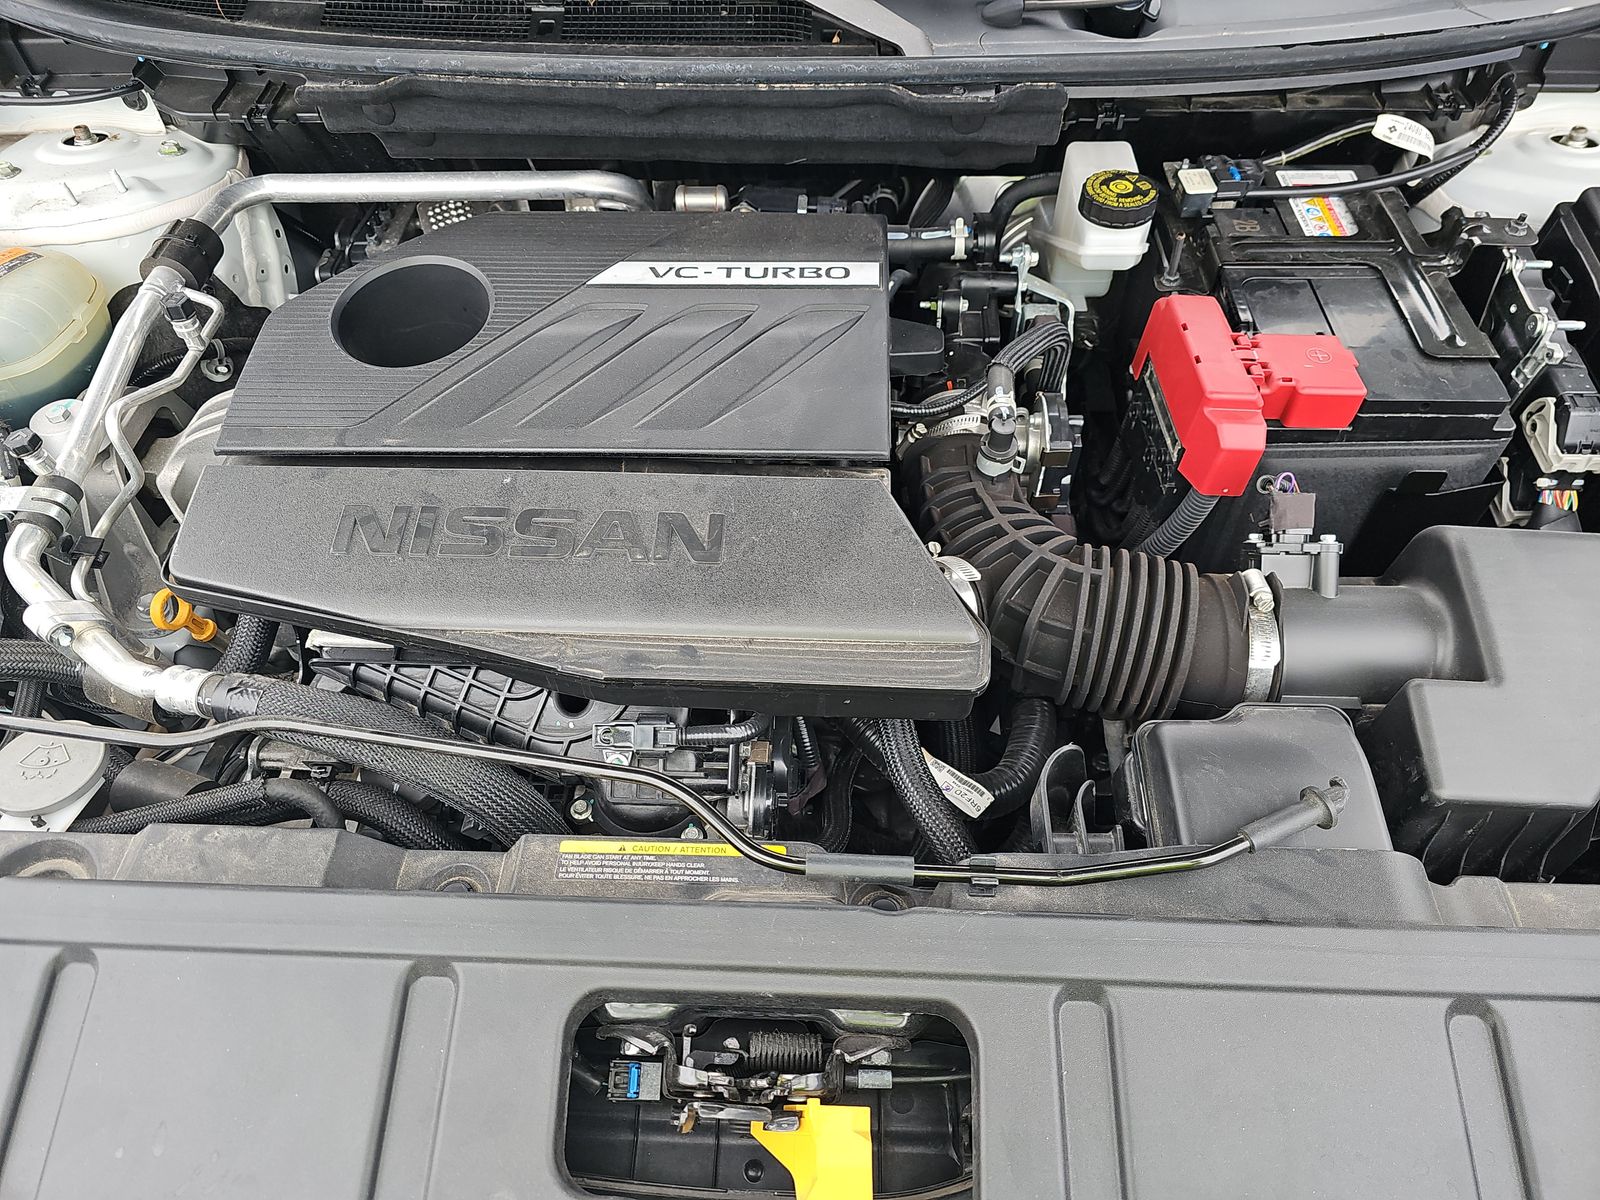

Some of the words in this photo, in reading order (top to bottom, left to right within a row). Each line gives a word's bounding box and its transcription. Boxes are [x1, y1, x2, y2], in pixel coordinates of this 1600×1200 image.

[648, 266, 851, 279] VC-TURBO
[329, 504, 726, 564] NISSAN
[679, 846, 727, 854] ATTENTION
